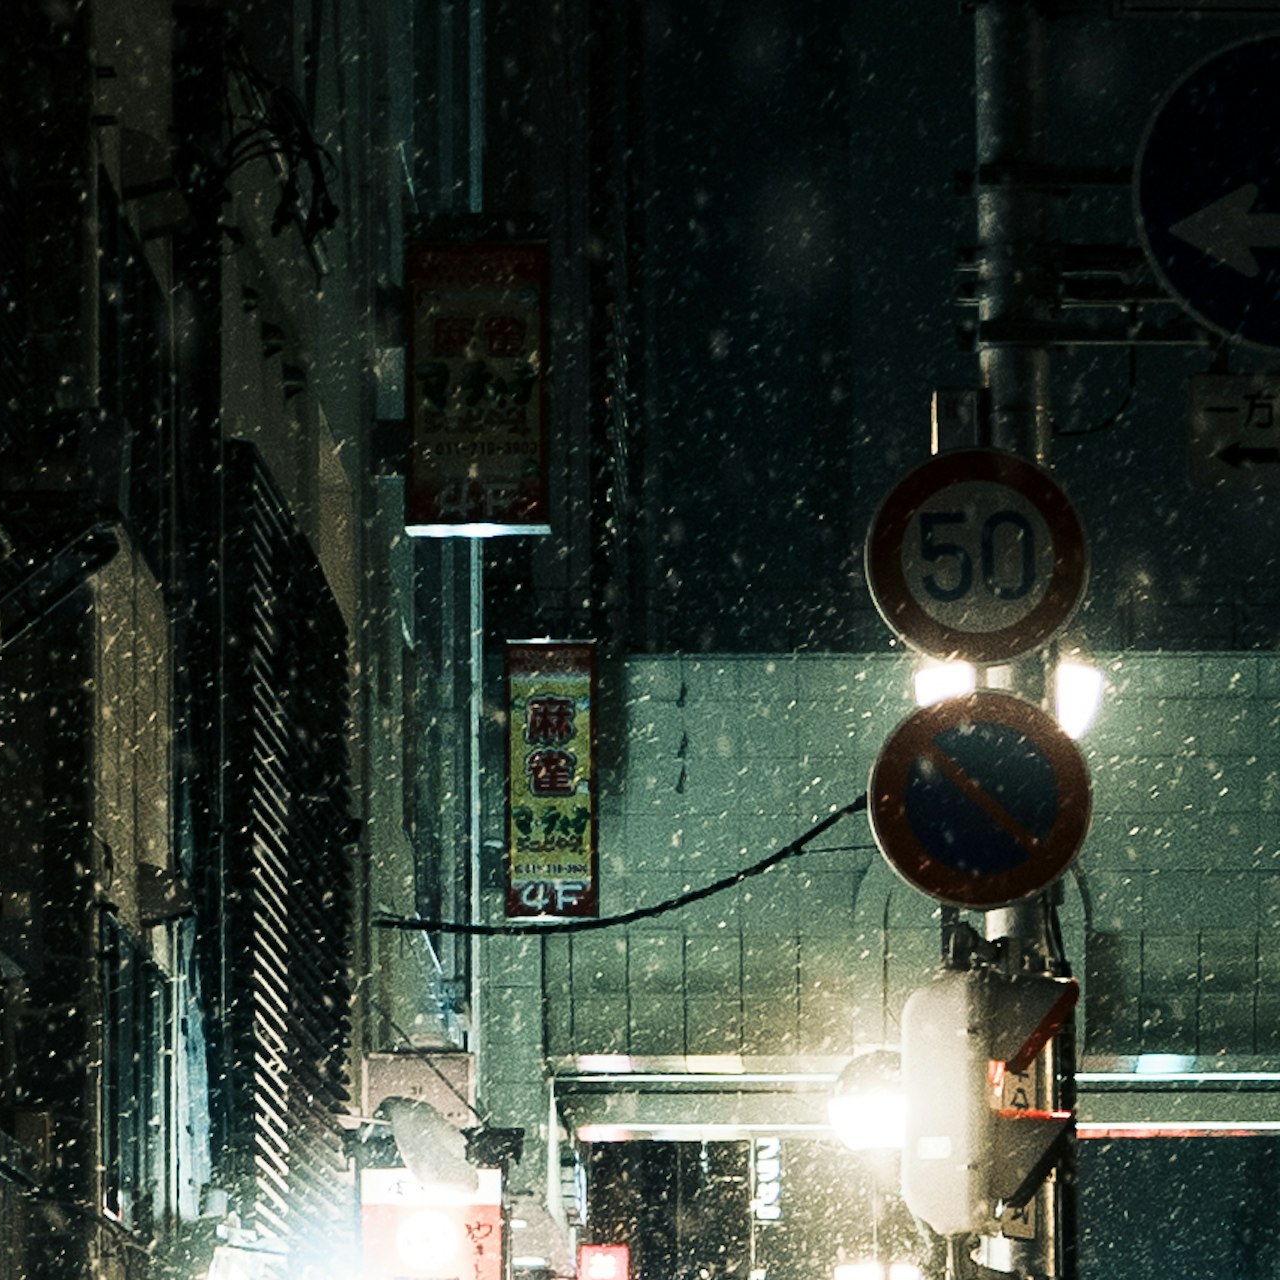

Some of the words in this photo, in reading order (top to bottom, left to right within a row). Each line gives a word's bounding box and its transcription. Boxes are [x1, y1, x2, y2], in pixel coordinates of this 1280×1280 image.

[918, 510, 1037, 604] 50
[525, 695, 577, 798] 麻雀
[521, 882, 582, 910] 4F
